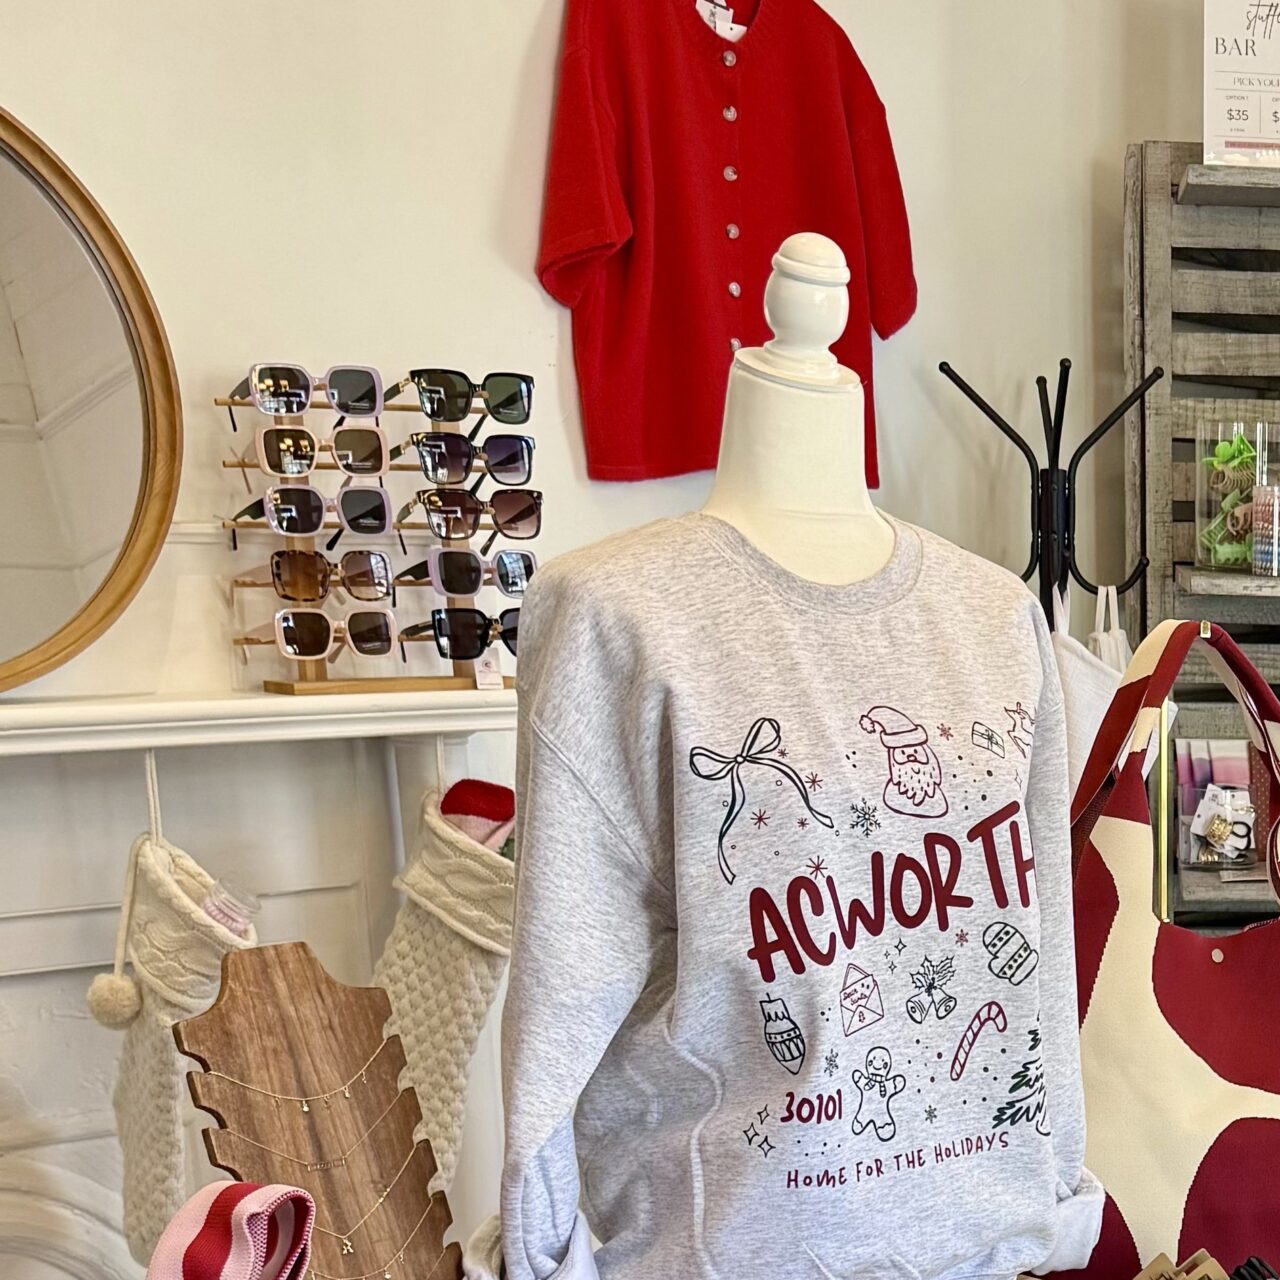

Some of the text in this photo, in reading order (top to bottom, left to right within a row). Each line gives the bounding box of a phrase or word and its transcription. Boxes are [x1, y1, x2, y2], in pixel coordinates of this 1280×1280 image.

[1214, 37, 1257, 57] BAR
[1233, 76, 1255, 87] PICK
[1226, 108, 1249, 121] $35
[747, 800, 1034, 983] ACWORTH
[780, 1088, 843, 1124] 30101
[786, 1131, 1010, 1189] HOME FOR THE HOLIDAYS
